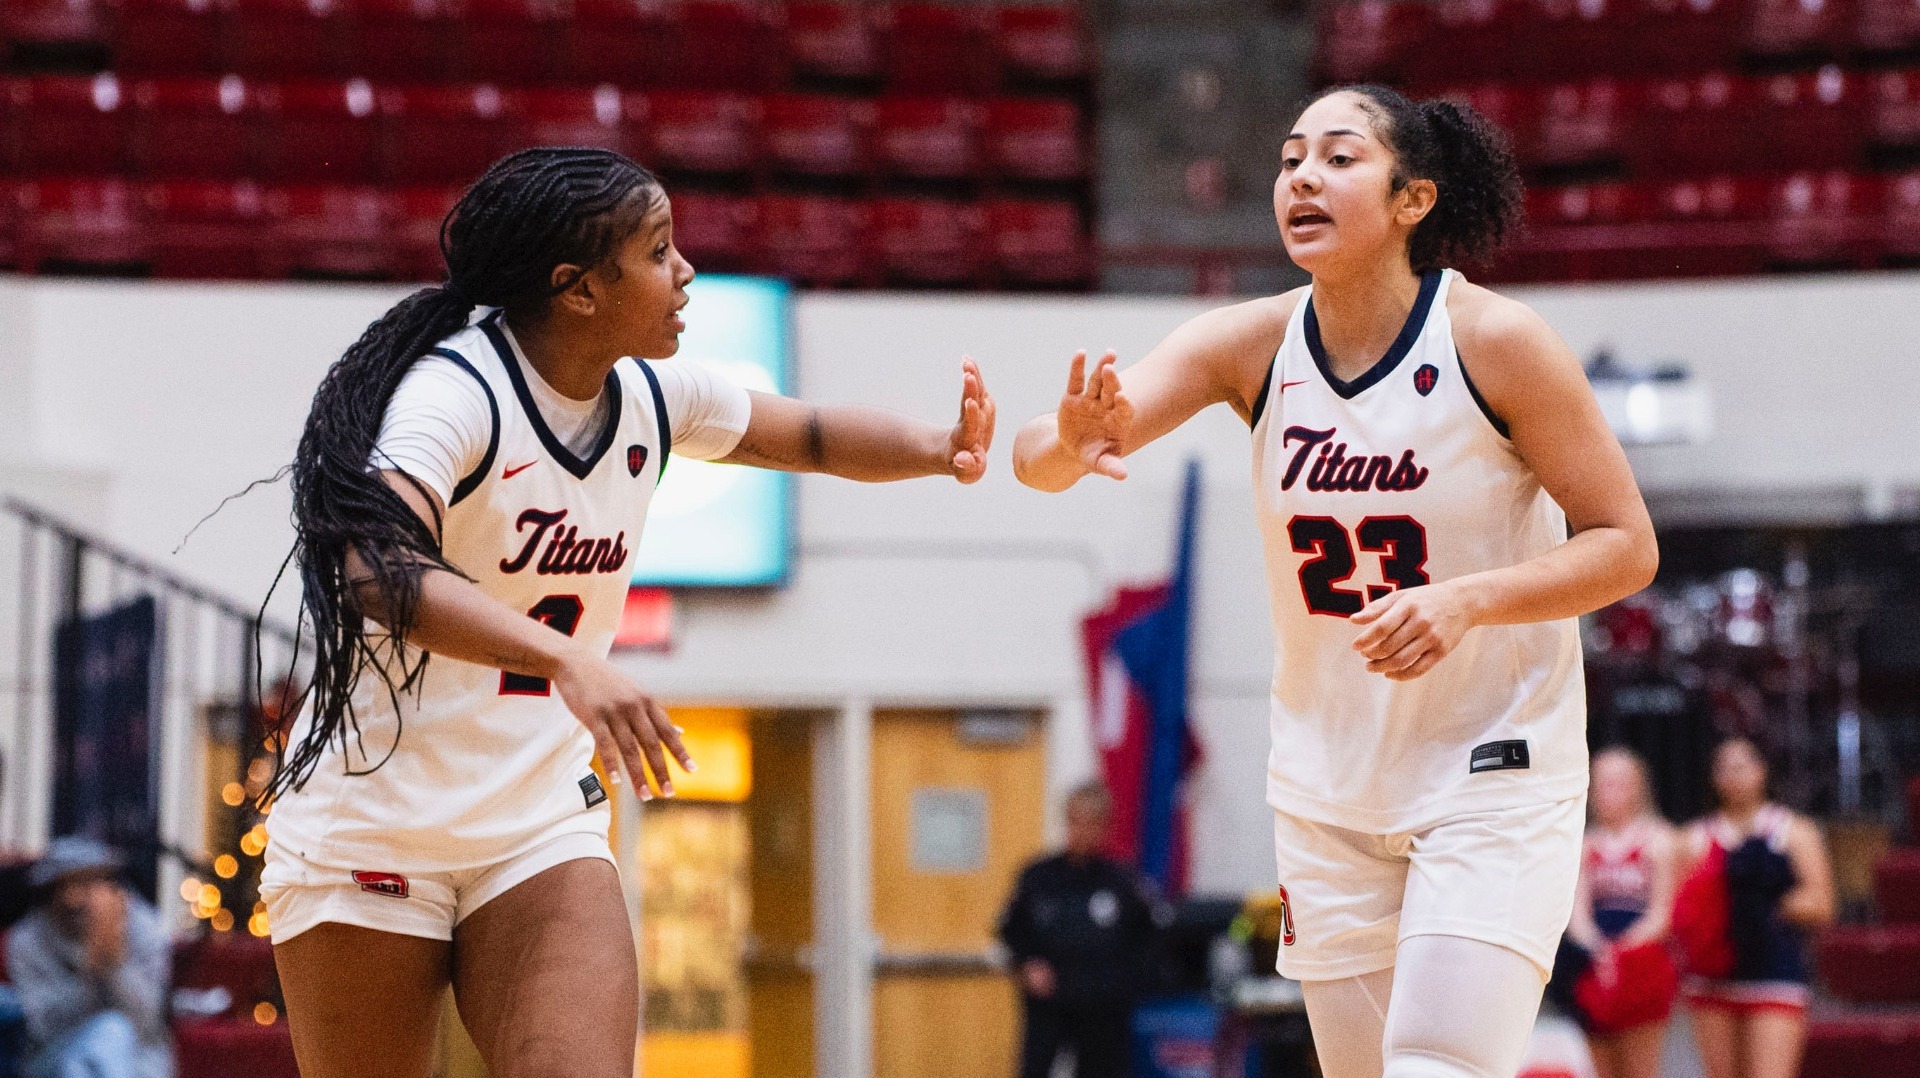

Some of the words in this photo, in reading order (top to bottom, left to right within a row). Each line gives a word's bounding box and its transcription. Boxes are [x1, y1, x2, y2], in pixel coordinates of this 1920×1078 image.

[1281, 425, 1429, 492] Titans
[499, 508, 628, 575] Titans
[1286, 514, 1430, 619] 23
[1512, 748, 1520, 760] L
